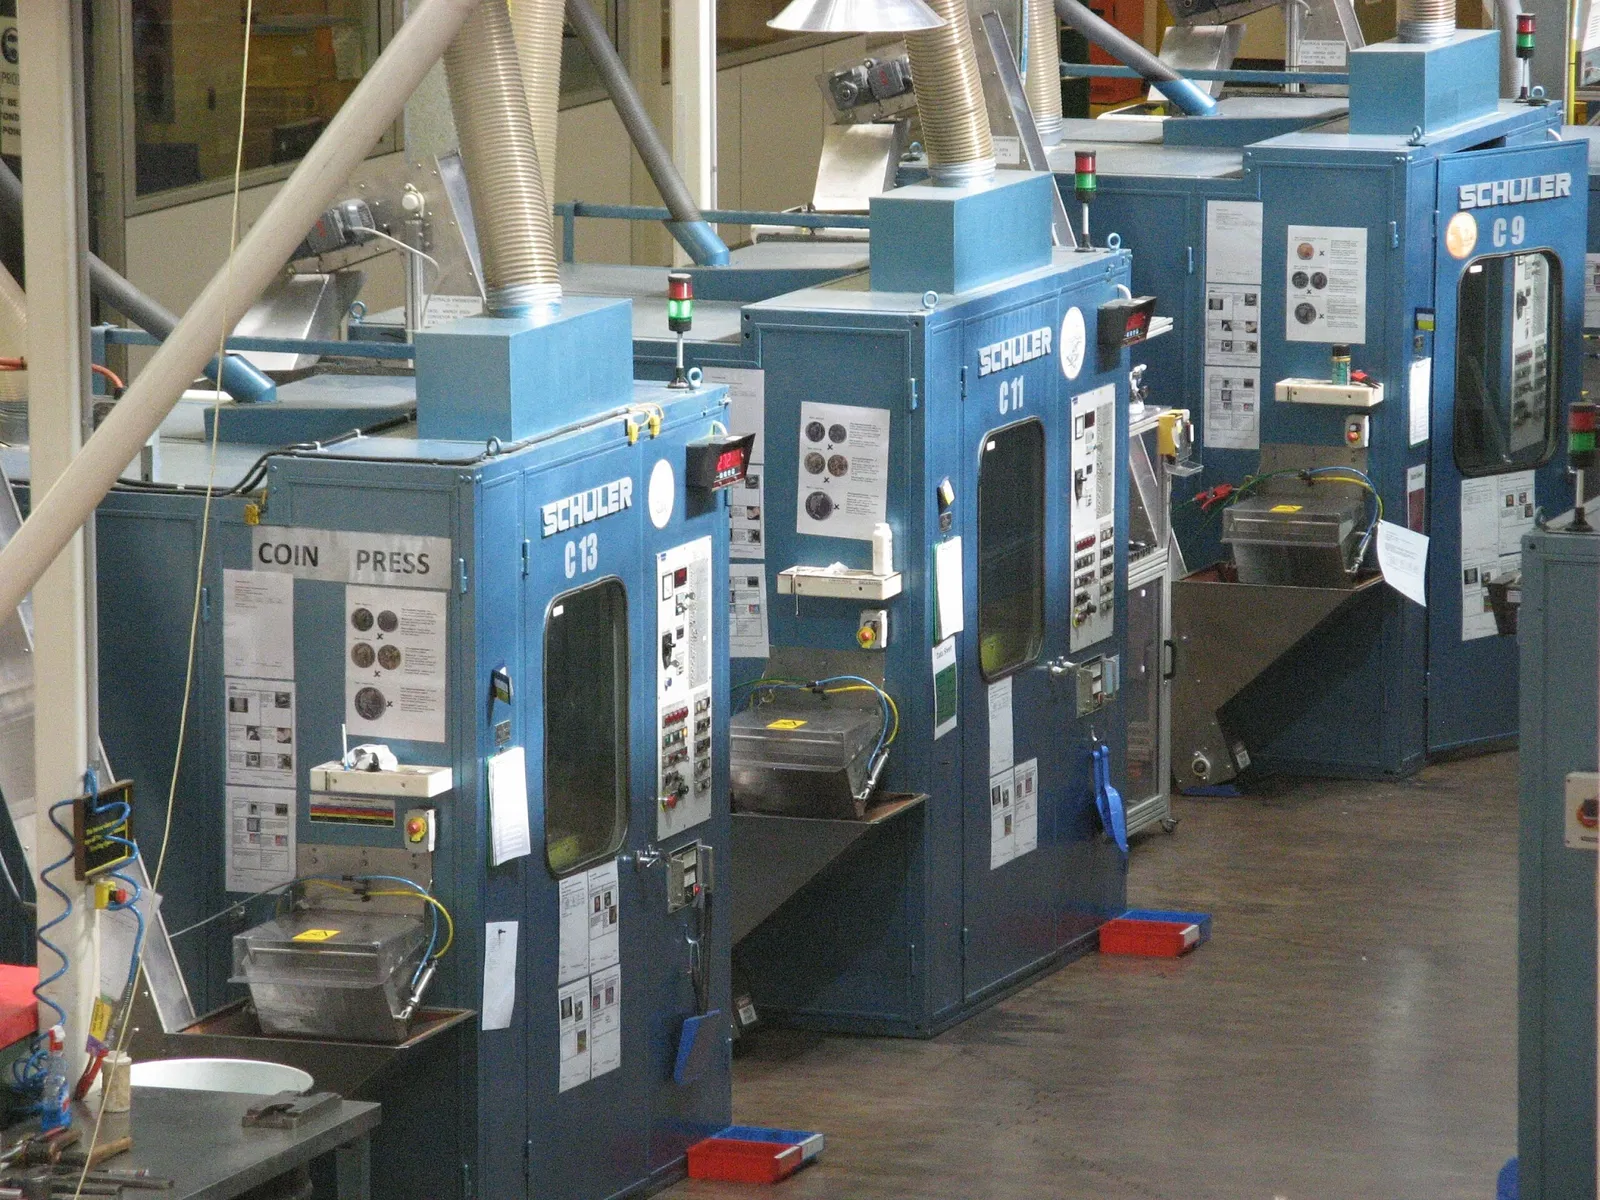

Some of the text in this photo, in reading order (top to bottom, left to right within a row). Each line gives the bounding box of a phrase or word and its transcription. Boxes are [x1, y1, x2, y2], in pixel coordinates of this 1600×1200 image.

[1459, 172, 1572, 209] SCHULER
[1493, 215, 1525, 248] C 9
[978, 326, 1052, 377] SCHULER
[999, 375, 1024, 415] C 11
[541, 476, 633, 537] SCHULER
[258, 542, 430, 575] COIN PRESS
[564, 532, 598, 579] C 13
